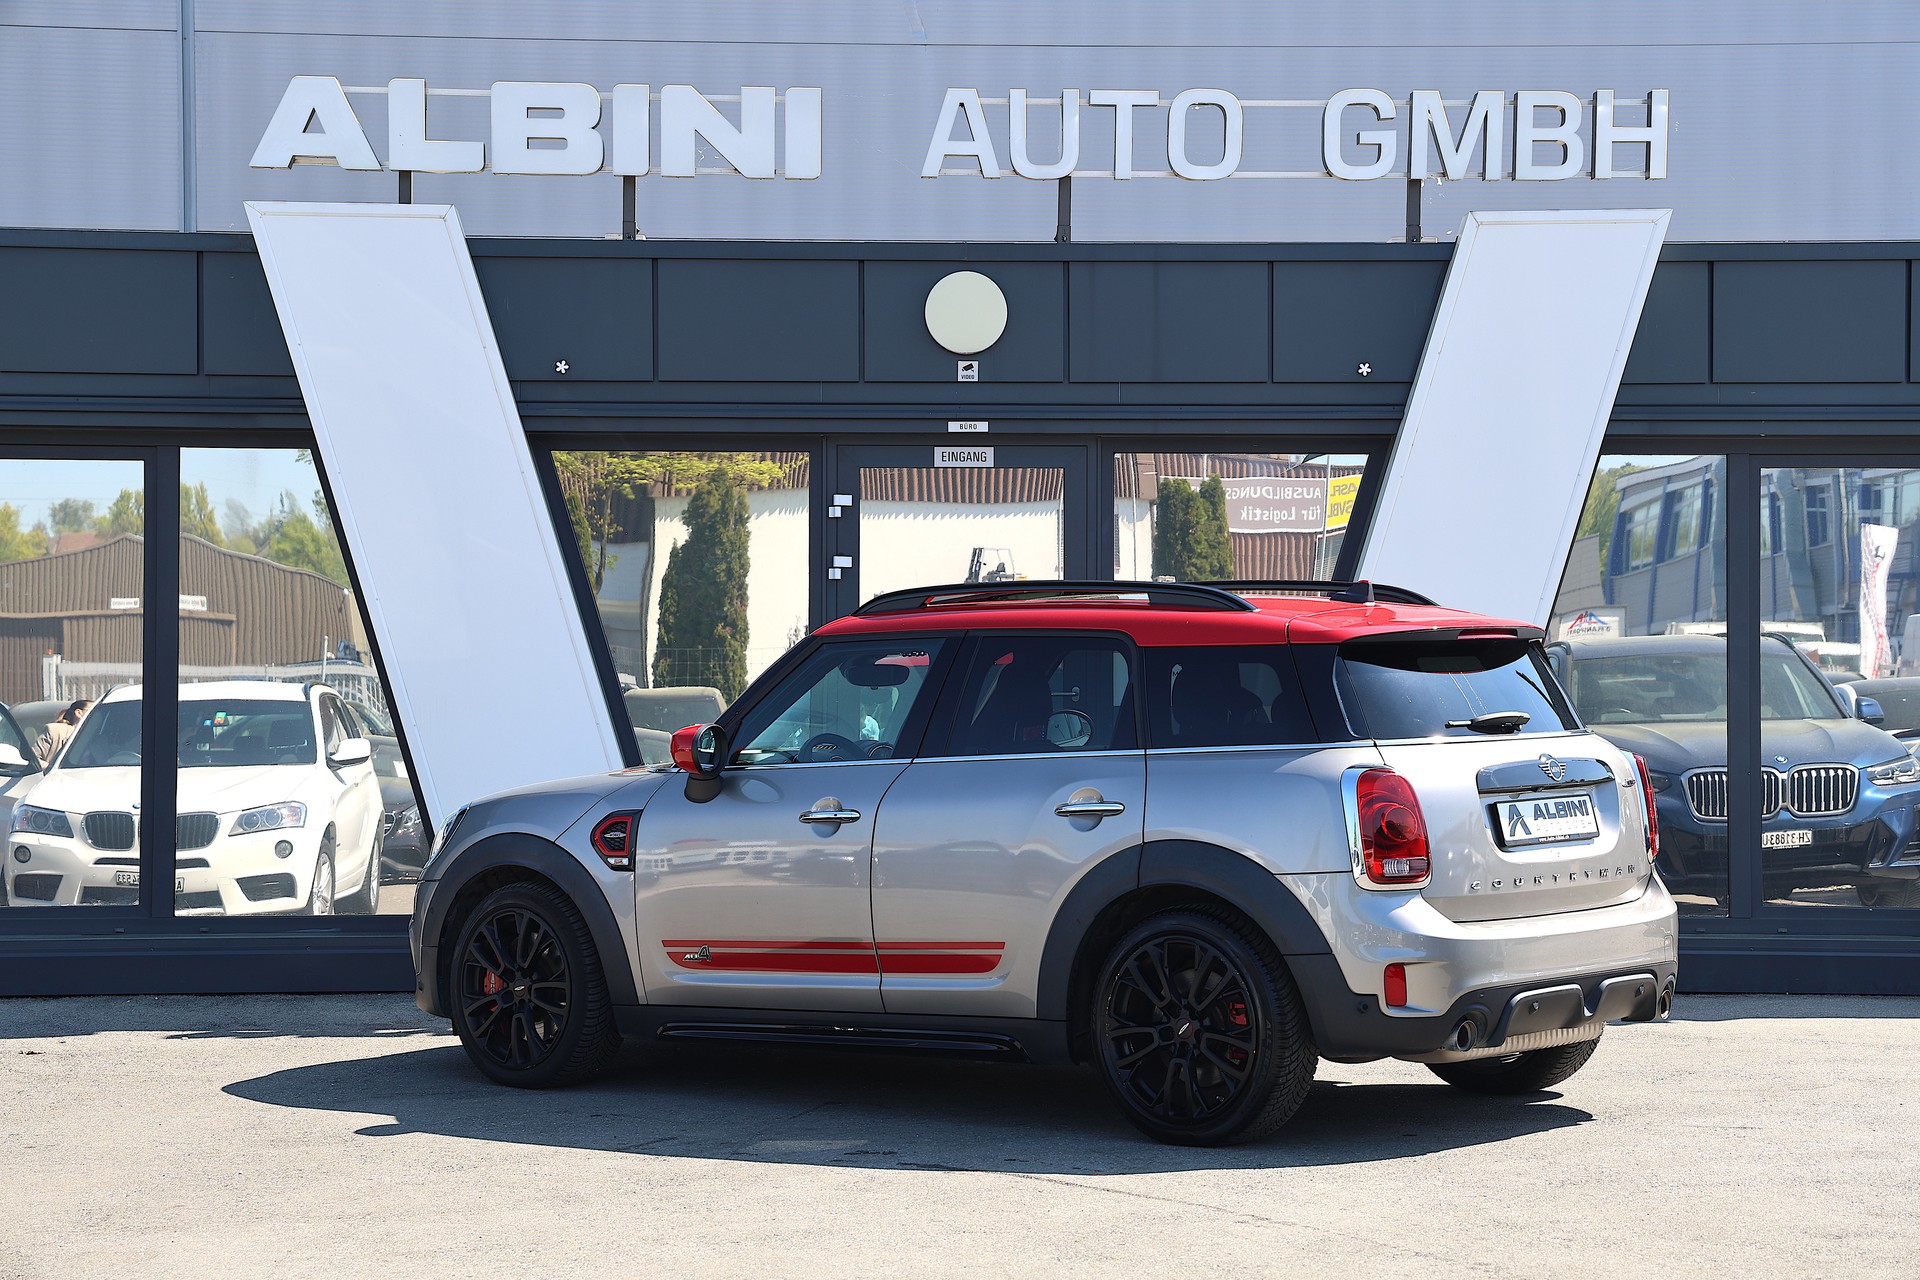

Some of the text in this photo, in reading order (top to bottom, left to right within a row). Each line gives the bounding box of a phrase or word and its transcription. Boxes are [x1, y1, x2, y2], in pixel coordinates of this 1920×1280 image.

[248, 75, 1670, 182] ALBINI AUTO GMBH
[941, 451, 987, 462] EINGANG
[1533, 799, 1589, 821] ALBINI
[1471, 865, 1635, 890] COUNTRYMAN
